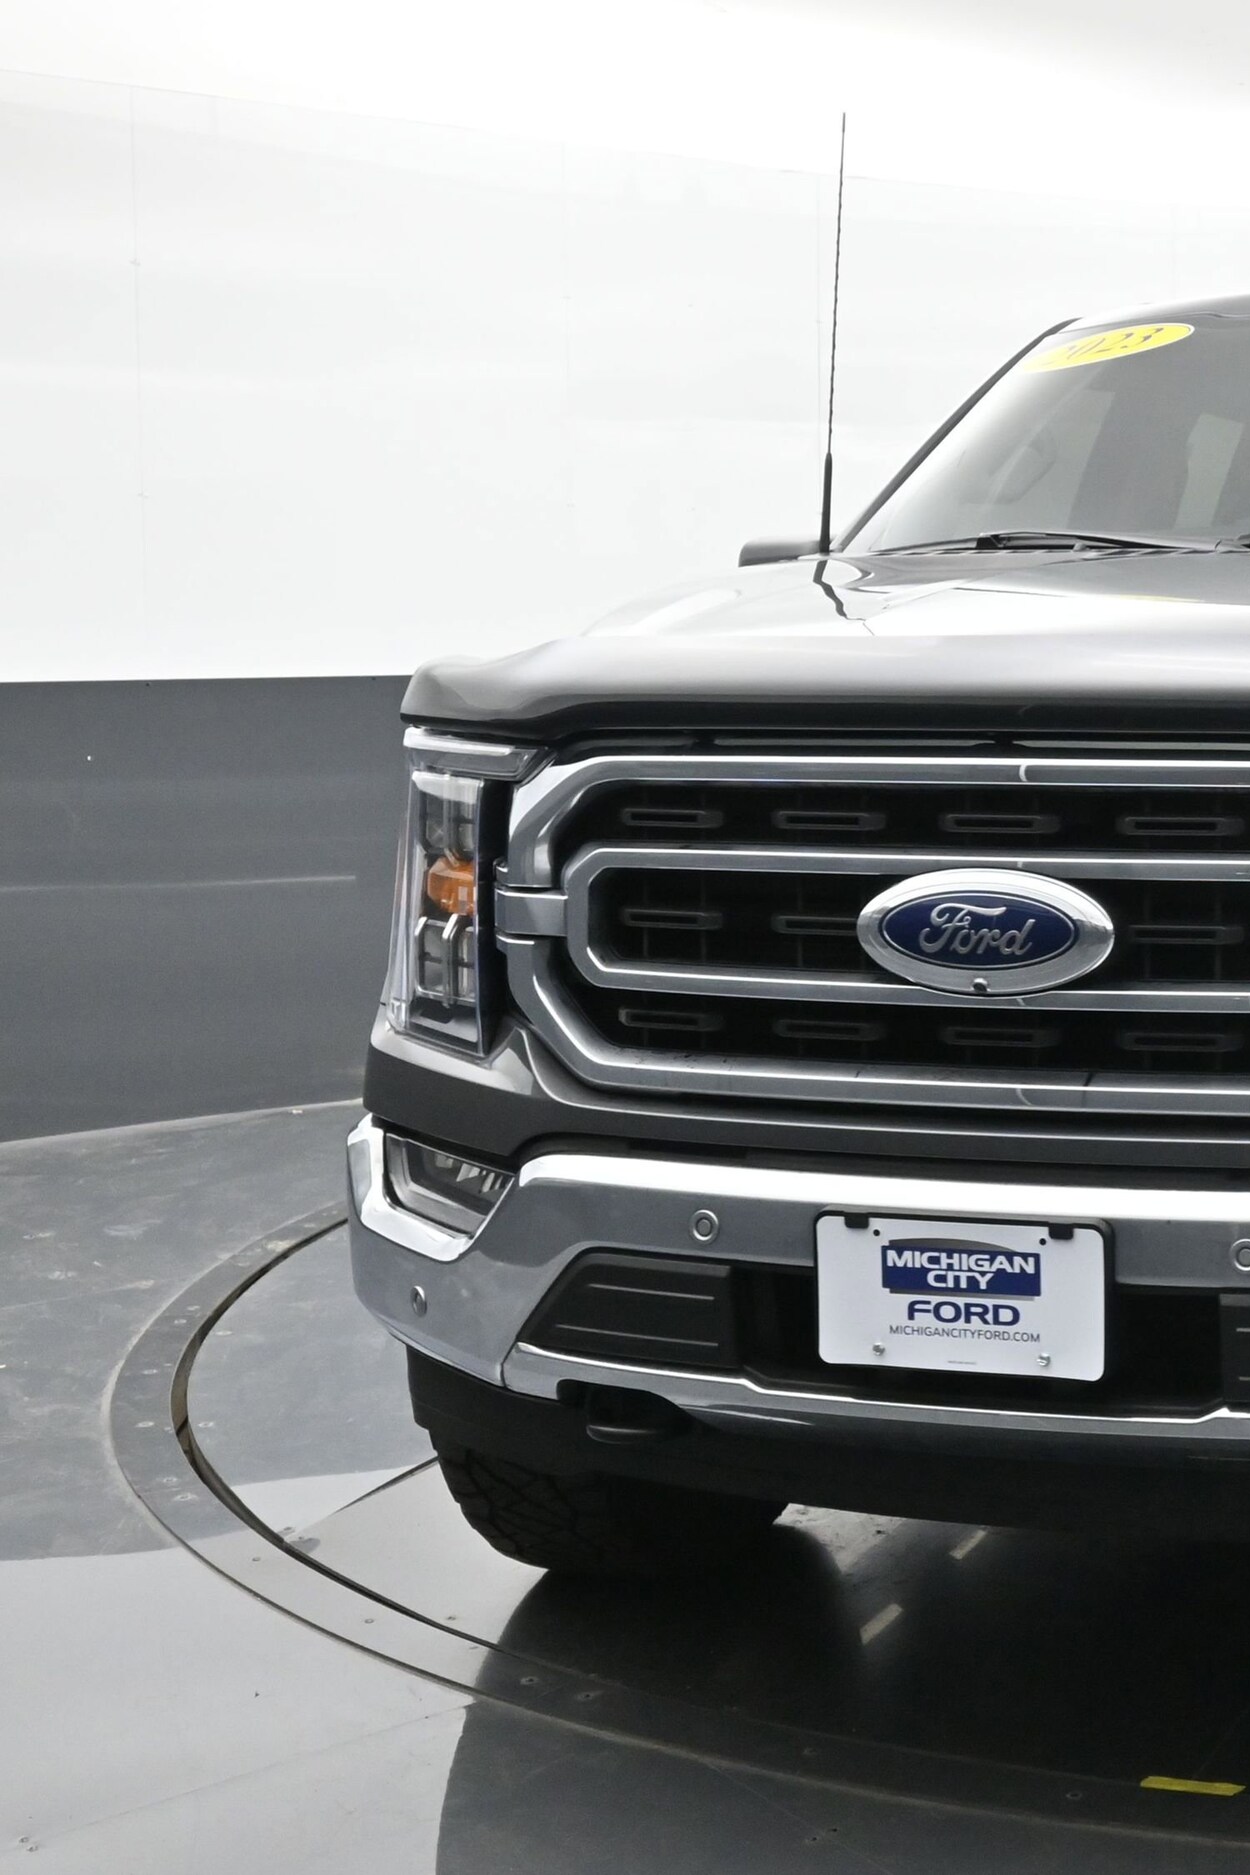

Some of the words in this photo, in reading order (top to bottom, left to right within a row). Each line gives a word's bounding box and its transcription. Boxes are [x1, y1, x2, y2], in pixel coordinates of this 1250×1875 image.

[919, 902, 1036, 955] Ford
[886, 1250, 1035, 1274] MICHIGAN
[927, 1270, 995, 1290] CITY
[907, 1300, 1021, 1326] FORD
[889, 1325, 1041, 1343] MICHIGANCITYFORD.COM
